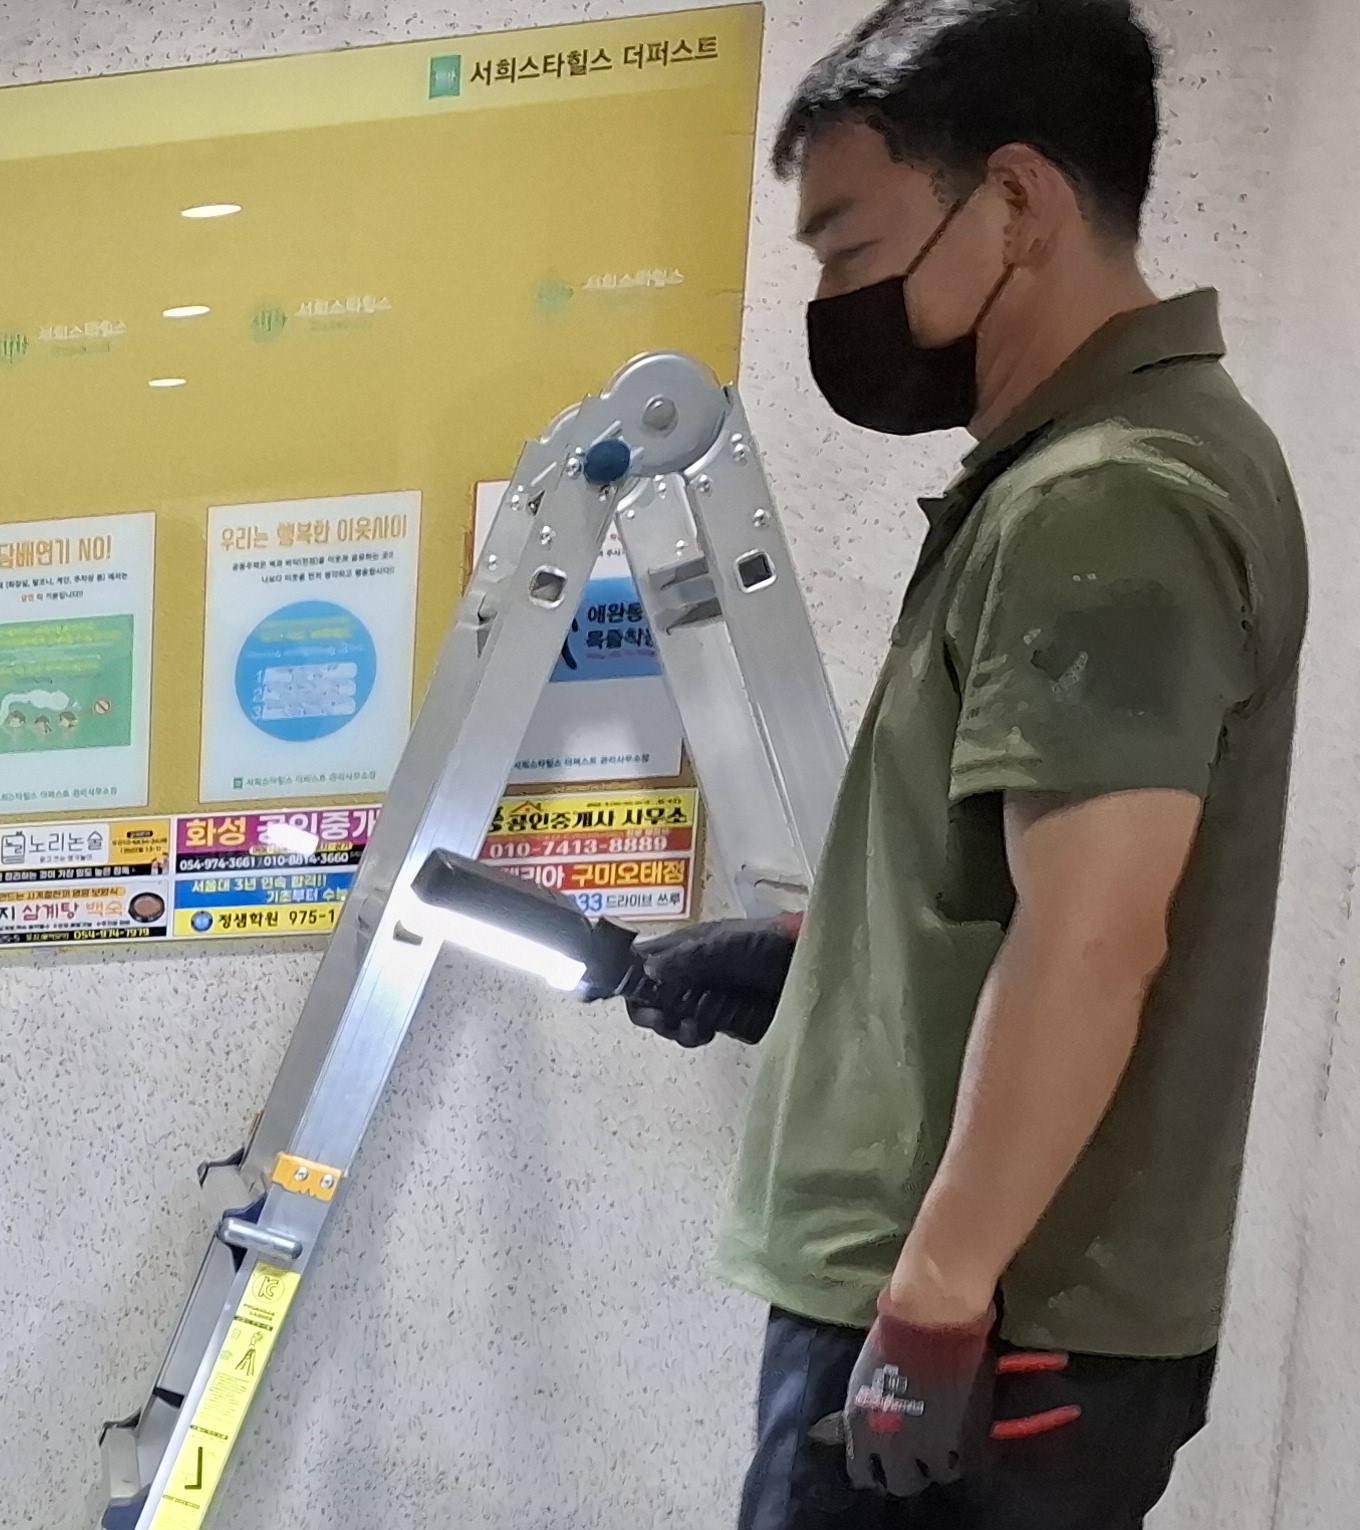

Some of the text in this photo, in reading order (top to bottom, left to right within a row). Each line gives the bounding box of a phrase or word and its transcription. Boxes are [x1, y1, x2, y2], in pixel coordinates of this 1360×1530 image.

[469, 35, 719, 87] 서희스타힐스 더퍼스트
[220, 514, 407, 551] 우리는 행복한 이웃사이
[79, 535, 112, 561] NO!
[186, 816, 246, 847] 화성
[507, 810, 614, 832] 공인중개사
[622, 808, 687, 825] 사무소
[29, 830, 103, 853] 노리논술
[192, 879, 230, 893] 서울대
[235, 877, 256, 891] 3년
[572, 860, 685, 887] 구미오태점
[266, 889, 318, 904] 기초부터
[607, 892, 681, 908] 드라이브 쓰루
[22, 902, 79, 920] 삼계탕
[85, 900, 123, 917] 백숙
[219, 910, 335, 928] 정샘학원 975-1
